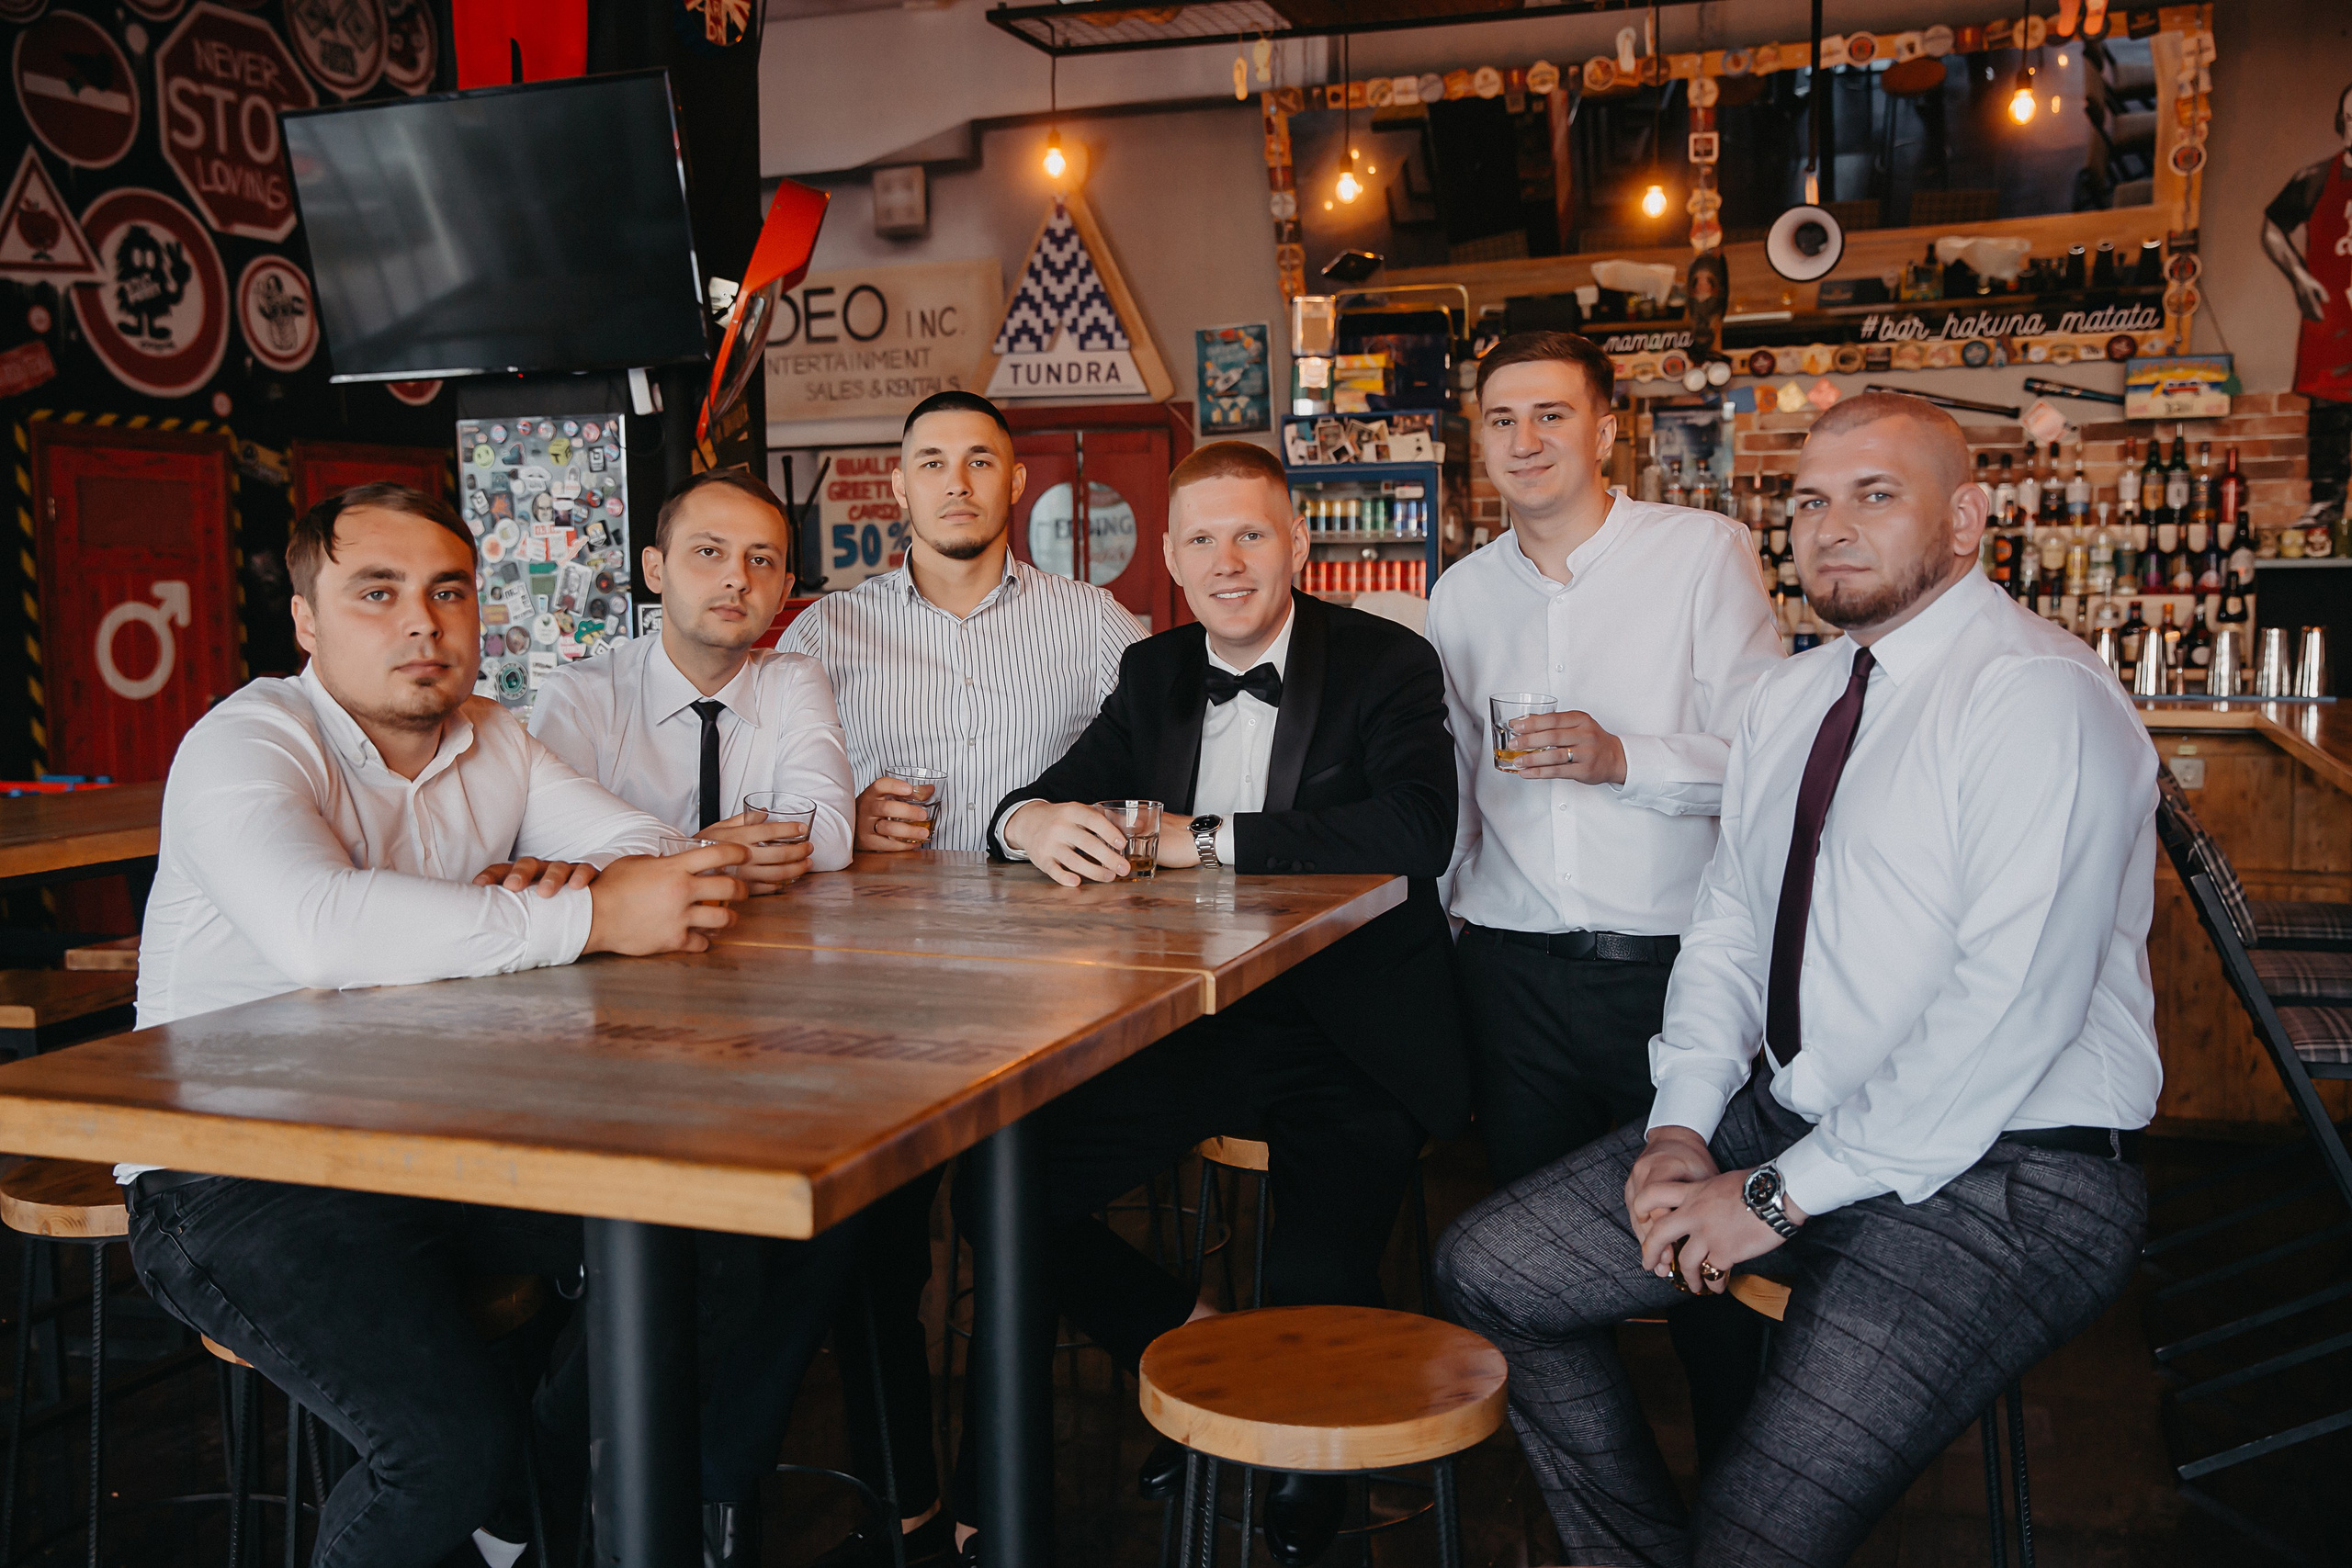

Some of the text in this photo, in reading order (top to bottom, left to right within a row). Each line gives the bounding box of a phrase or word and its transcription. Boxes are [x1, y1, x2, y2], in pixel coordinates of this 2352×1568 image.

[194, 39, 288, 94] NEVER
[168, 75, 279, 164] STO
[196, 155, 288, 209] LOVING
[806, 379, 864, 401] SALES
[1010, 361, 1121, 385] TUNDRA
